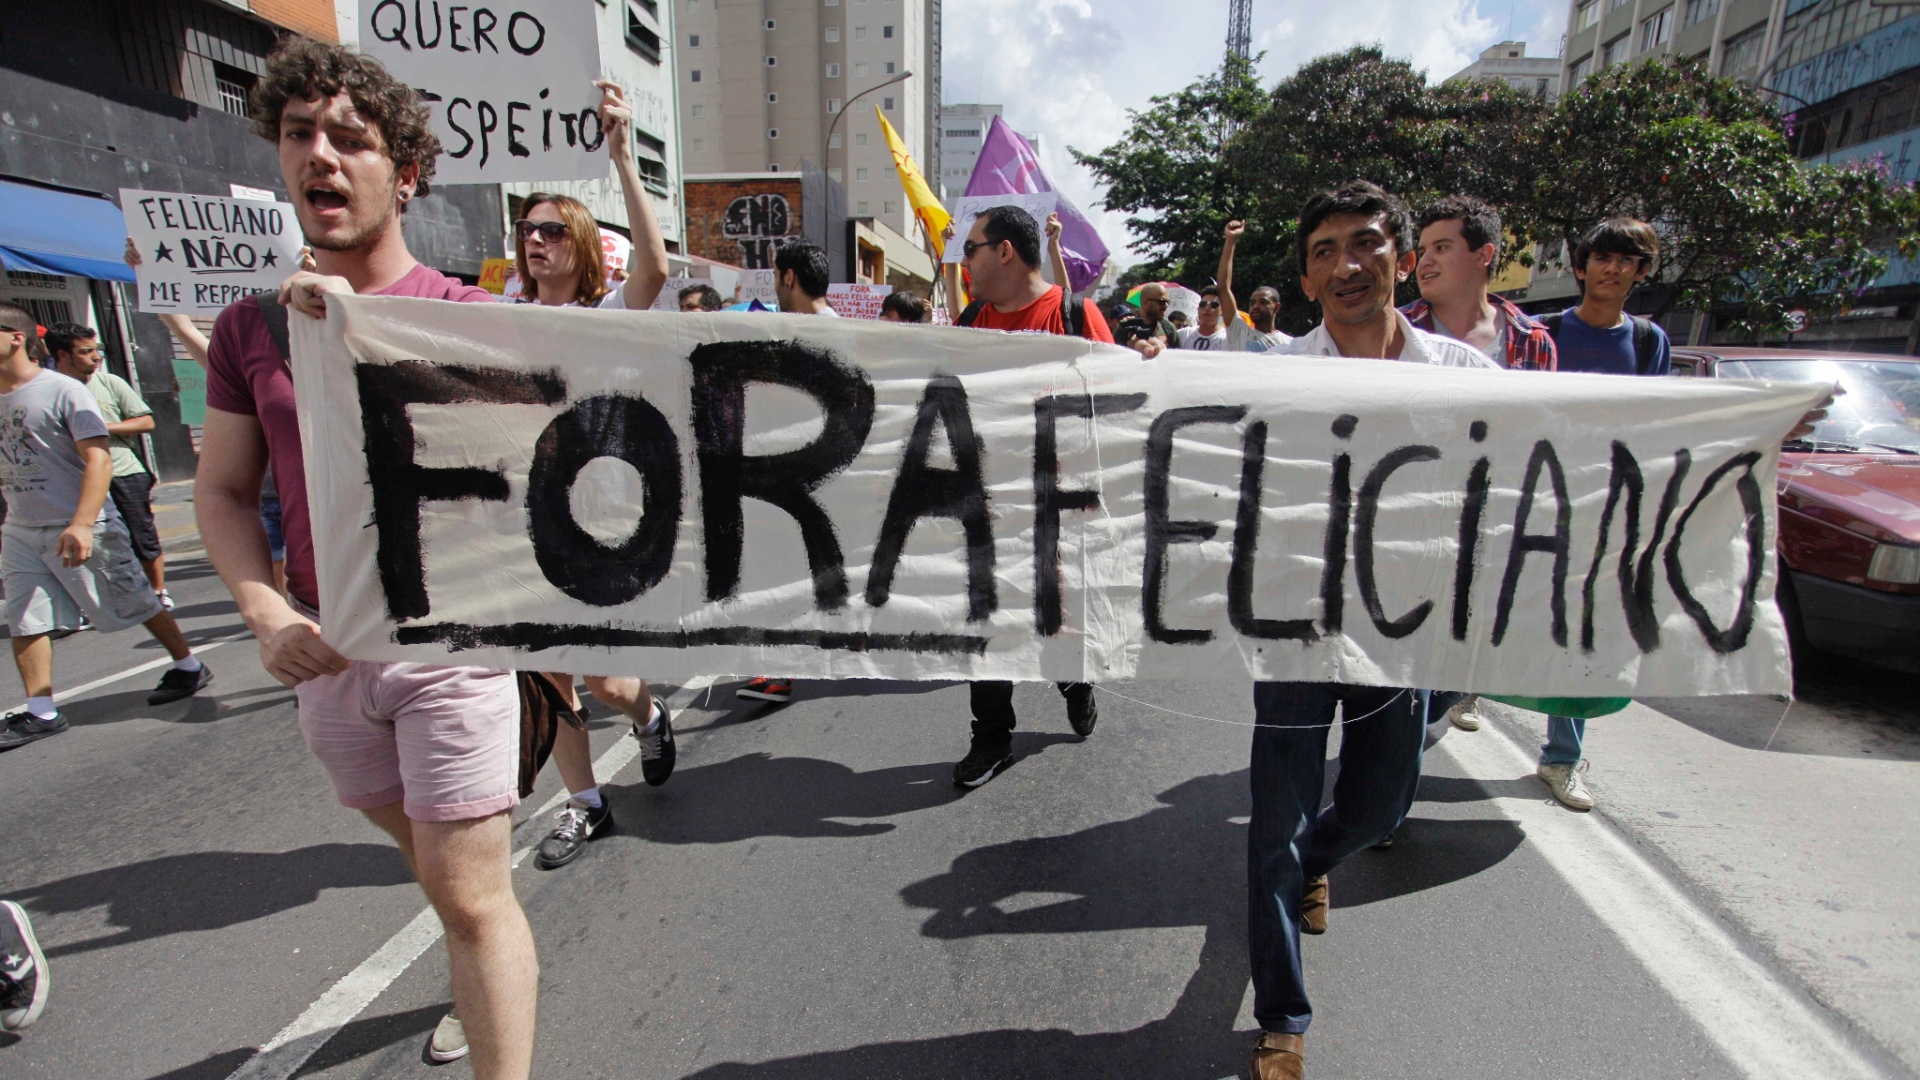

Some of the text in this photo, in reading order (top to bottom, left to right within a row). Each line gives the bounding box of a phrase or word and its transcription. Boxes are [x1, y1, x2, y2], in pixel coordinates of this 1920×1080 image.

[371, 0, 546, 56] QUERO
[414, 87, 605, 170] SPEITO
[180, 235, 257, 269] NÃO
[10, 280, 67, 289] CLAUDIO
[150, 281, 181, 303] ME
[850, 285, 871, 293] FORA
[851, 293, 886, 301] FELICIAN
[355, 338, 998, 622] FORA
